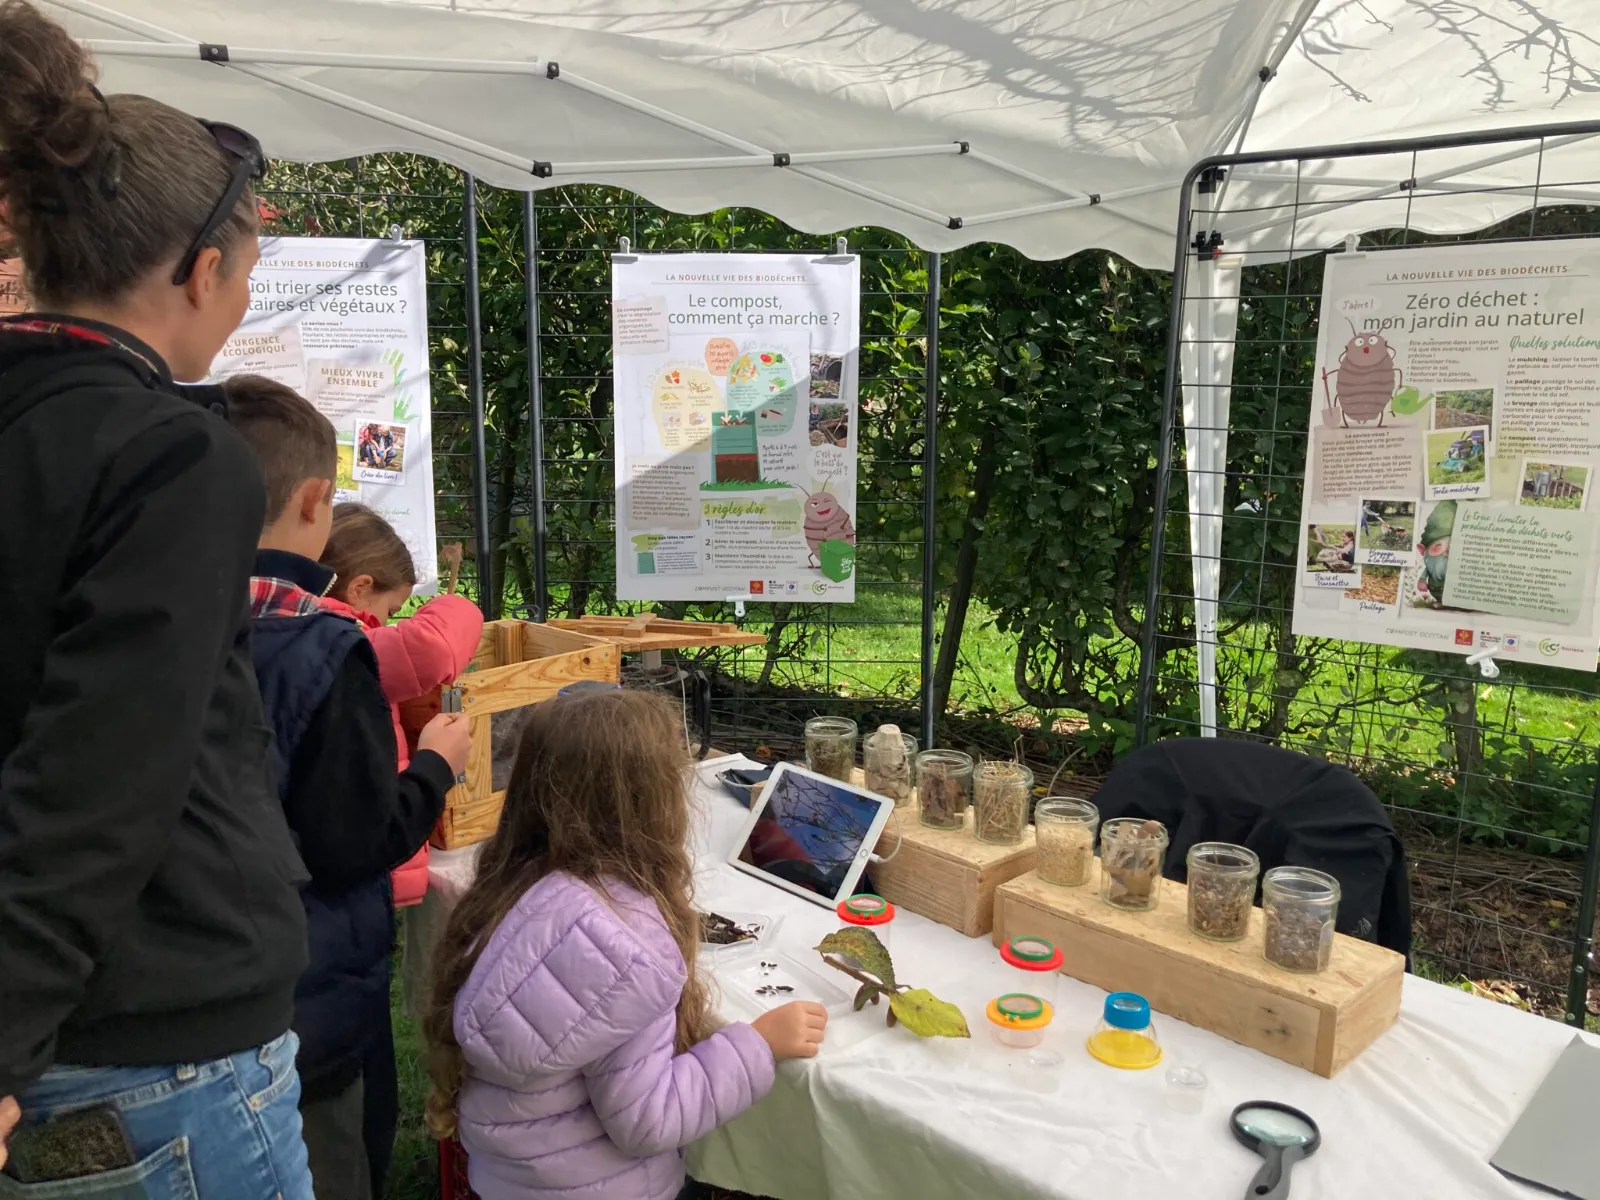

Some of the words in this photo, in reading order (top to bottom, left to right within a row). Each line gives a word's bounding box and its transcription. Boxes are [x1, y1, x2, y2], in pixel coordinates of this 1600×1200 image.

[317, 260, 369, 268] BIODÉCHETS
[756, 274, 806, 282] BIODÉCHETS
[1402, 270, 1454, 280] NOUVELLE
[1477, 268, 1496, 276] DES
[1500, 265, 1568, 276] BIODÉCHETS
[276, 281, 311, 294] trier
[316, 284, 342, 294] ses
[348, 283, 397, 296] restes
[248, 298, 293, 311] taires
[300, 299, 314, 312] et
[321, 299, 394, 316] végétaux
[400, 300, 407, 313] ?
[689, 294, 706, 307] Le
[711, 296, 782, 311] compost,
[1406, 293, 1450, 310] Zéro
[1456, 290, 1526, 308] déchet
[669, 312, 742, 325] comment
[748, 313, 764, 328] ça
[769, 311, 828, 325] marche
[833, 313, 839, 325] ?
[1364, 316, 1404, 330] mon
[1409, 311, 1468, 333] jardin
[1475, 314, 1499, 328] au
[1507, 308, 1584, 326] naturel
[226, 336, 280, 347] L'URGENCE
[1510, 336, 1549, 352] Quelles
[223, 345, 286, 356] ÉCOLOGIQUE
[322, 368, 352, 376] MIEUX
[356, 370, 384, 379] VIVRE
[327, 378, 378, 387] ENSEMBLE
[704, 504, 710, 514] 3
[713, 501, 744, 519] règles
[746, 501, 766, 514] d'or
